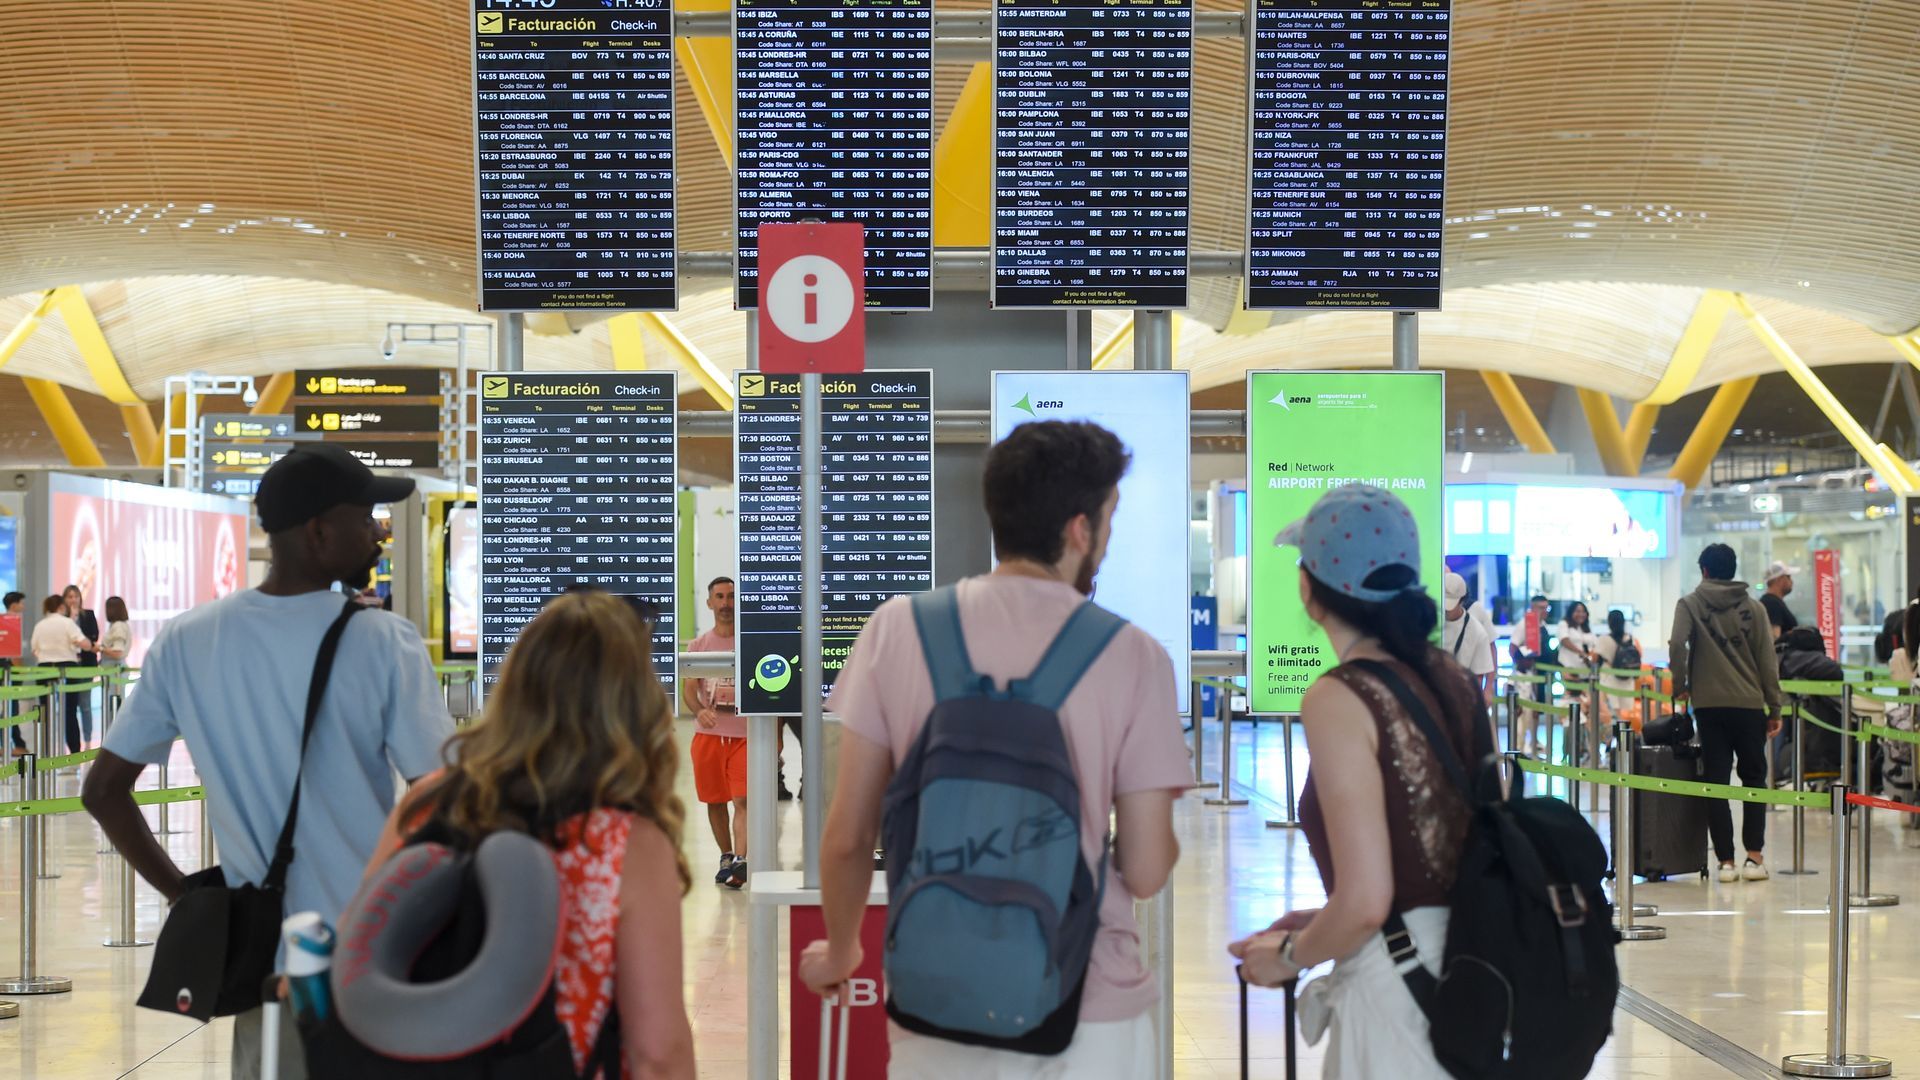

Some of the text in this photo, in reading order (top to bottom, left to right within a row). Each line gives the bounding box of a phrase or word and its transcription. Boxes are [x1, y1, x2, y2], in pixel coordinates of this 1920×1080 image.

[509, 18, 657, 31] Facturación Check-in
[766, 30, 797, 38] CORUÑA
[514, 382, 660, 395] Facturación Check-in
[770, 381, 916, 394] Factación Check-in
[1269, 462, 1334, 471] Red Network
[1269, 477, 1323, 488] AIRPORT
[1392, 478, 1426, 489] AENA
[741, 594, 759, 602] 18:00
[1268, 645, 1319, 656] Wifi gratis
[1277, 658, 1321, 667] ilimitado
[1268, 672, 1308, 682] Free and
